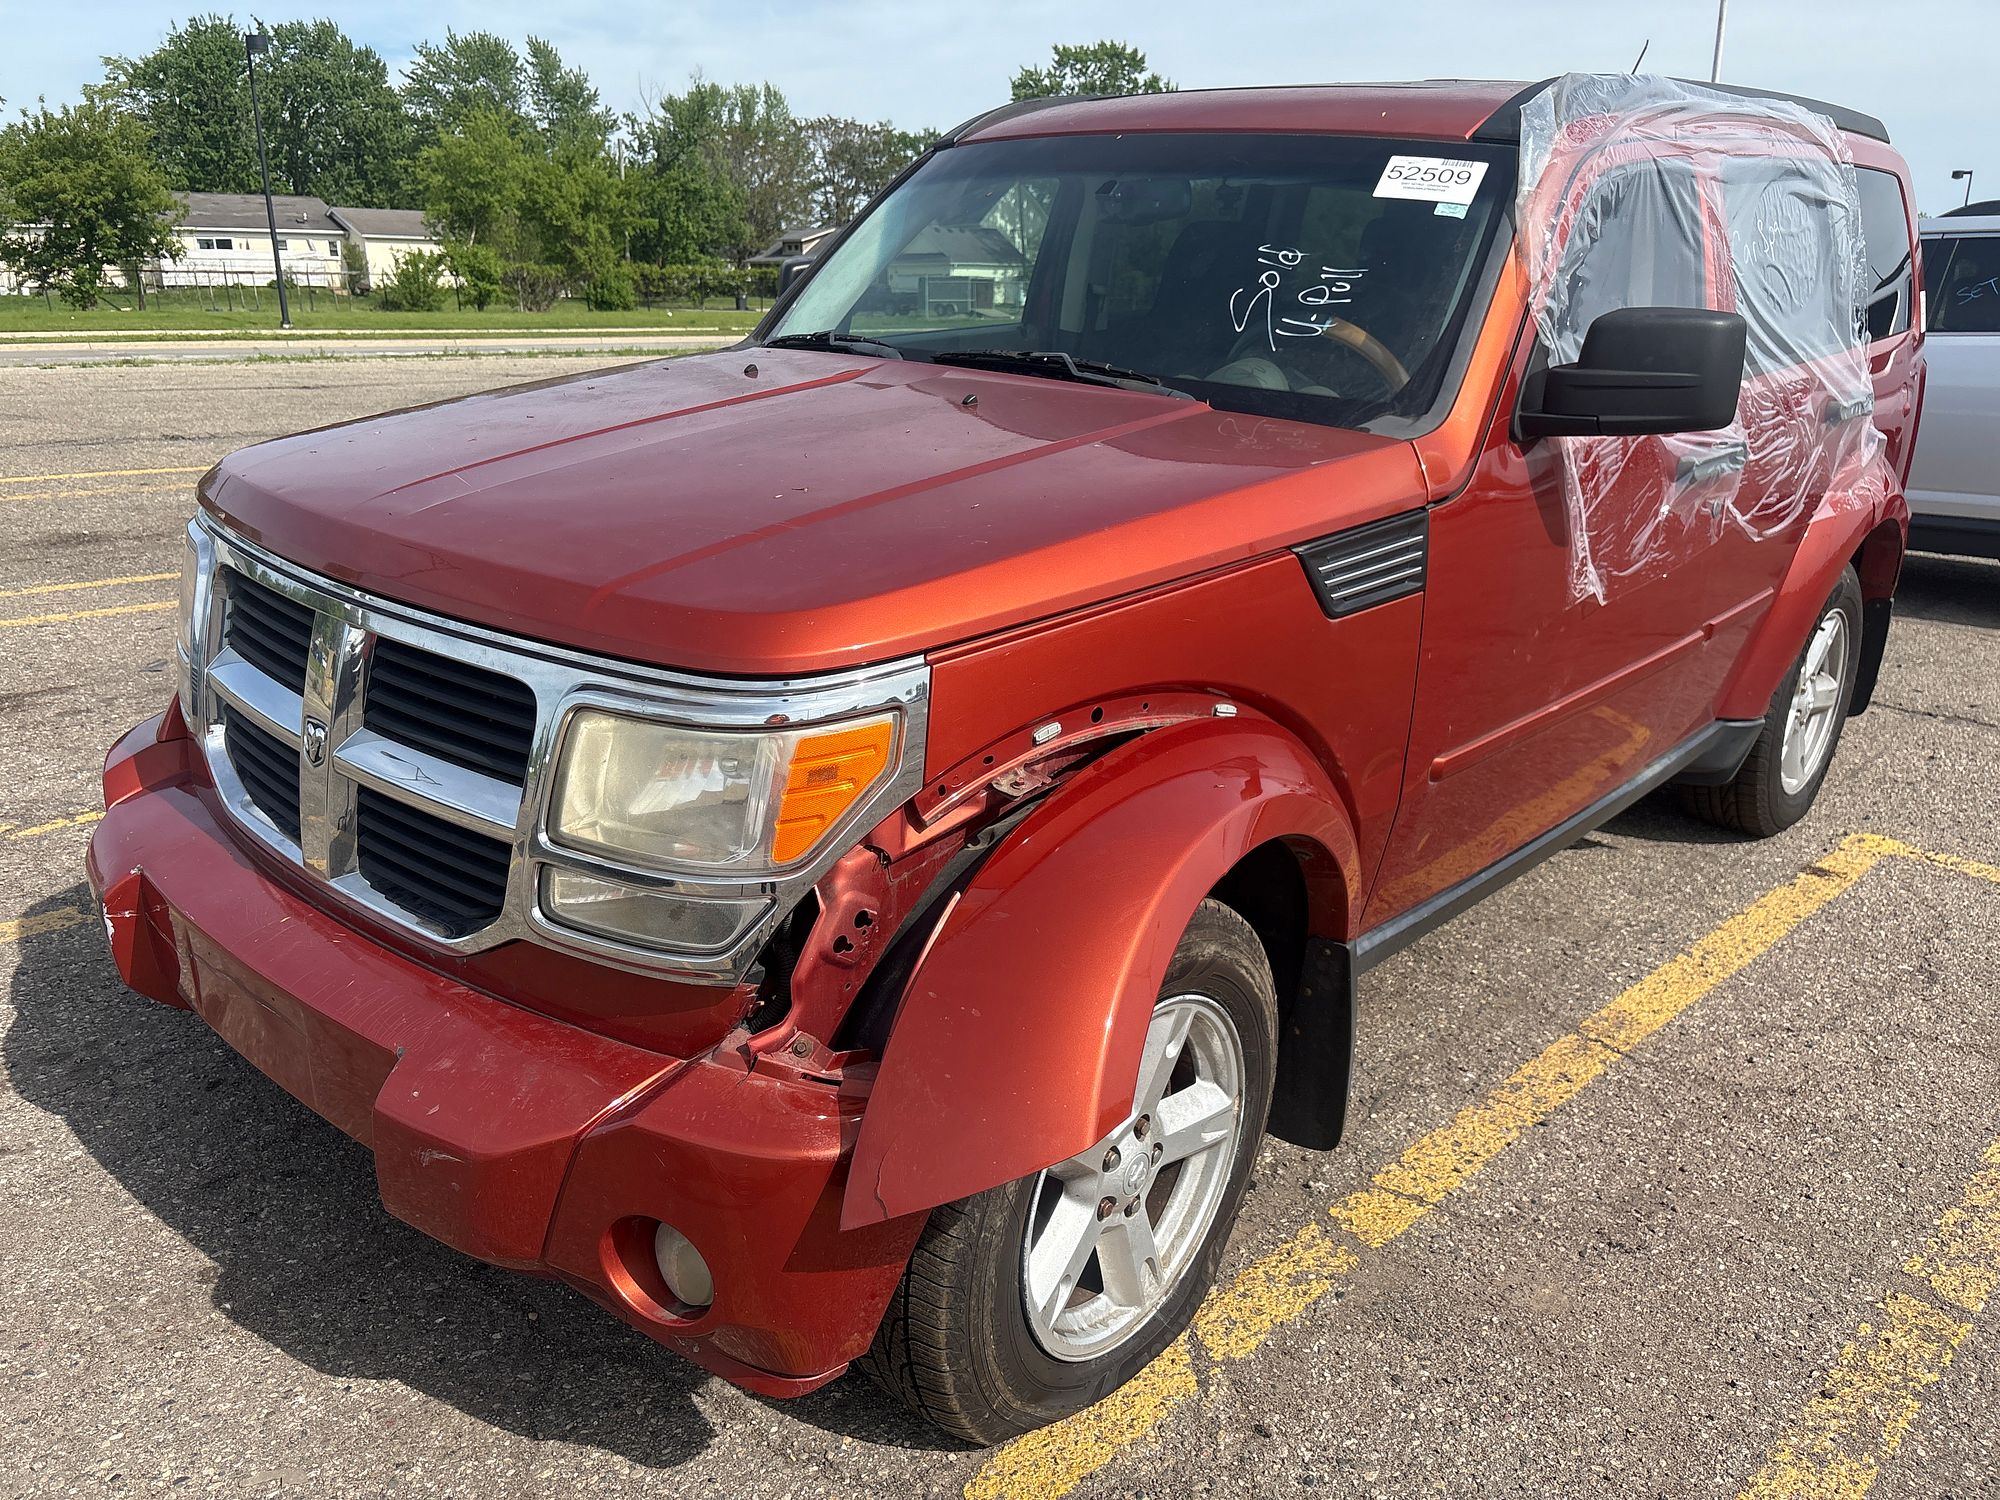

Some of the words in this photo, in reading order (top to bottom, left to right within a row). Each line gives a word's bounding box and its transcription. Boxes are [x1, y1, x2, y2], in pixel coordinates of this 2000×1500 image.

[1387, 165, 1472, 185] 52509
[1229, 244, 1311, 352] Sold
[1956, 277, 1998, 305] SET
